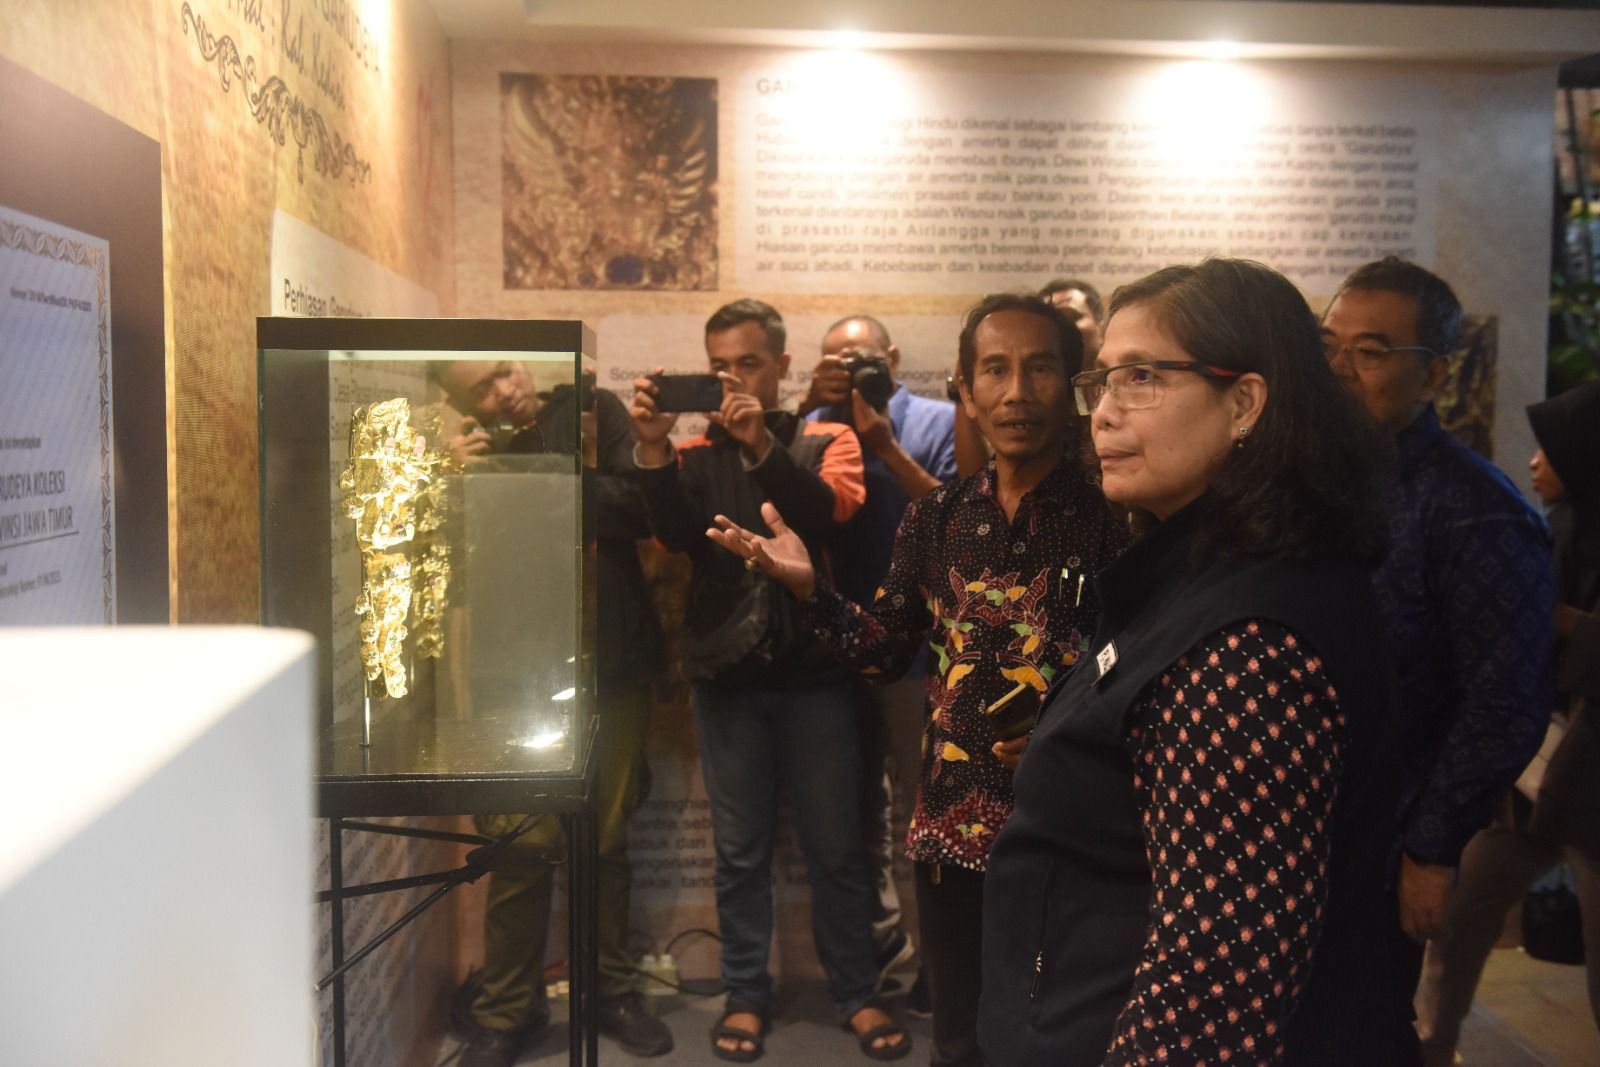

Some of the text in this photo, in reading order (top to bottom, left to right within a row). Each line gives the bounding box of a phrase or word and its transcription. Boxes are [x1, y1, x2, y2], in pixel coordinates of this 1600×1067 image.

[1013, 118, 1066, 134] sebagai
[906, 224, 990, 240] Airlangga
[1050, 228, 1121, 241] memang
[33, 470, 65, 496] KOLEKSI
[22, 509, 47, 536] JAWA
[48, 505, 73, 531] TIMUR
